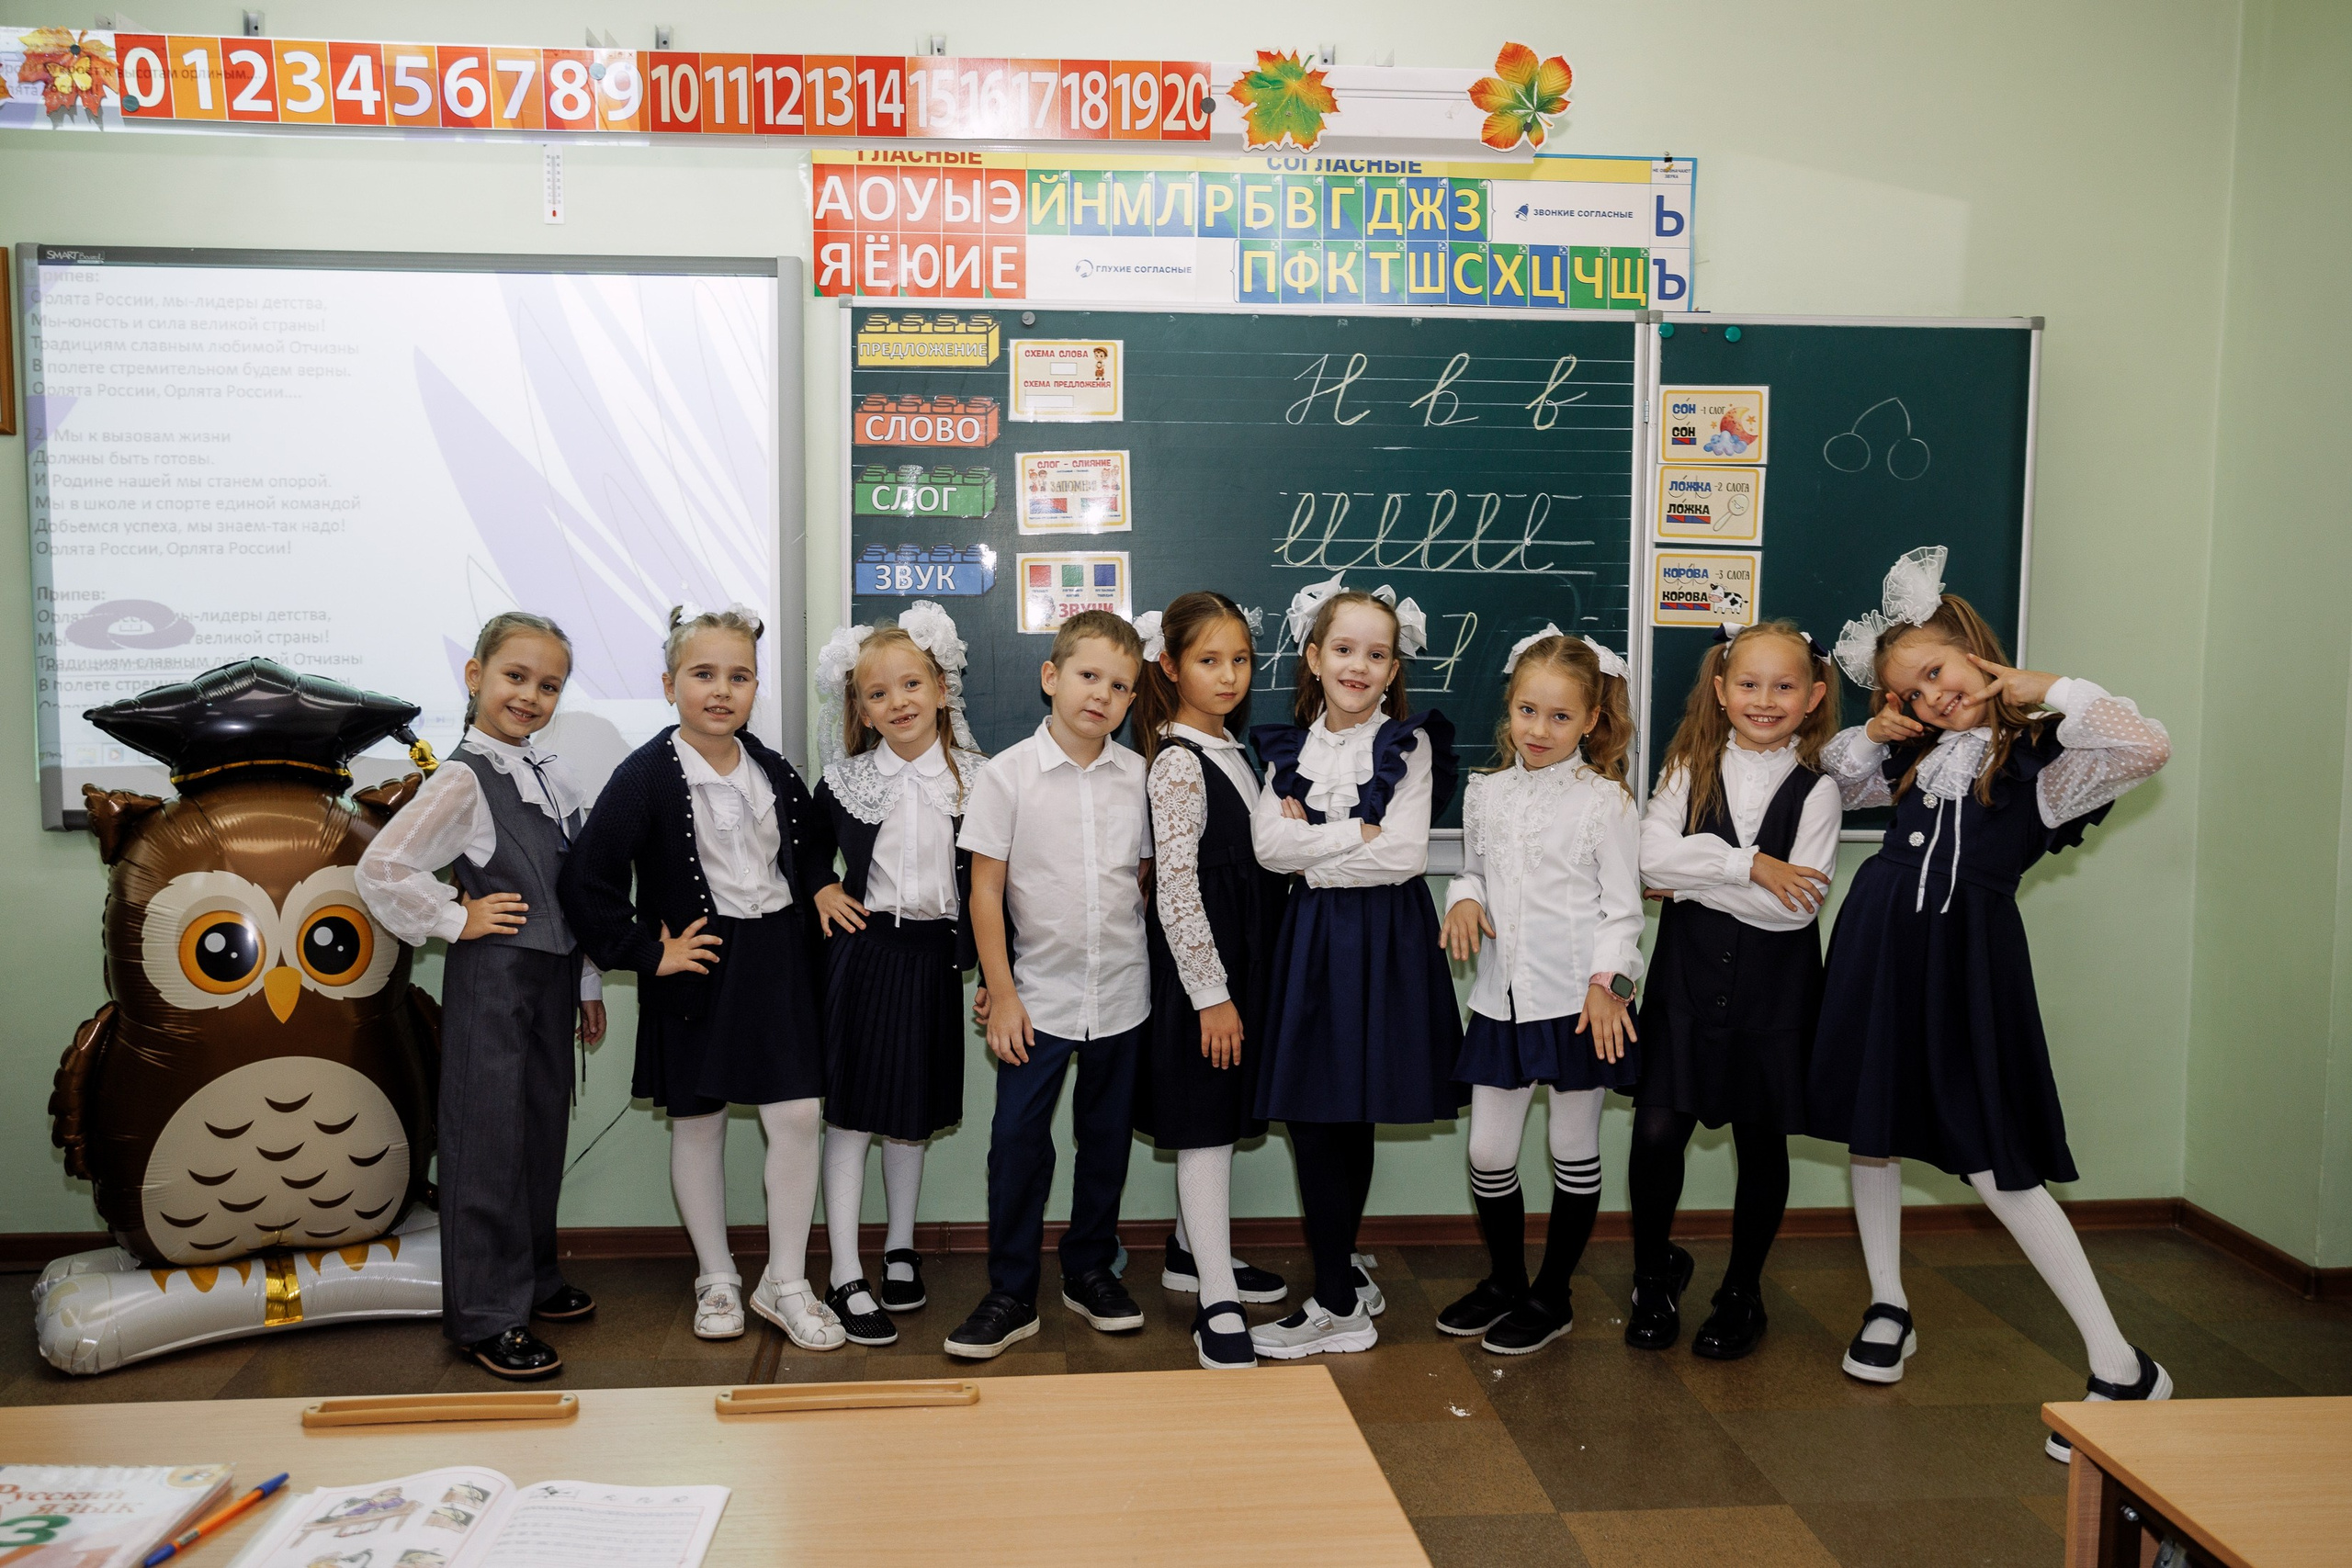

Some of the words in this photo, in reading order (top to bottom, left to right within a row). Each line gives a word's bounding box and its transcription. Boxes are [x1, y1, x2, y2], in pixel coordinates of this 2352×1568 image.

[123, 47, 165, 107] 0
[183, 49, 213, 109] 1
[230, 50, 273, 111] 2
[284, 51, 324, 113] 3
[335, 54, 380, 116] 4
[394, 56, 434, 117] 5
[444, 56, 487, 119] 6
[496, 60, 537, 119] 7
[549, 62, 592, 120] 8
[605, 62, 643, 121] 9
[650, 63, 699, 123] 10
[705, 65, 749, 125] 11
[755, 66, 804, 126] 12
[806, 66, 854, 127] 13
[857, 68, 904, 128] 14
[909, 69, 957, 129] 15
[960, 69, 1007, 130] 16
[1012, 71, 1057, 130] 17
[1061, 71, 1108, 130] 18
[1113, 72, 1159, 131] 19
[1162, 73, 1209, 131] 20
[1533, 209, 1575, 217] ЗВОНКИЕ
[1577, 209, 1634, 219] СОГЛАСНЫЕ
[47, 250, 78, 260] SMART
[1096, 265, 1132, 274] ГЛУХИЕ
[1134, 265, 1193, 274] СОГЛАСНЫЕ
[96, 291, 159, 309] России,
[163, 297, 258, 311] мы-лидеры
[262, 299, 327, 311] детства,
[31, 312, 128, 329] Мы-юность
[133, 319, 142, 329] и
[148, 319, 186, 330] сила
[191, 316, 258, 331] великой
[263, 318, 326, 333] страны!
[31, 335, 126, 354] Традициям
[130, 340, 204, 353] славным
[209, 339, 285, 354] любимой
[289, 341, 359, 355] Отчизны
[859, 342, 988, 359] ПРЕДЛОЖЕНИЕ
[1024, 349, 1055, 358] СХЕМА
[1058, 350, 1089, 358] СЛОВА
[32, 357, 42, 372] В
[48, 364, 105, 374] полете
[109, 363, 238, 377] стремительном
[243, 362, 292, 379] будем
[298, 366, 352, 379] верны.
[32, 381, 92, 398] Орлята
[97, 383, 161, 399] России,
[164, 384, 221, 400] Орлята
[1054, 380, 1112, 389] ПРЕДЛОЖЕНИЯ
[54, 428, 83, 442] Мы
[89, 432, 97, 442] к
[102, 432, 175, 443] вызовам
[178, 432, 232, 443] жизни
[865, 415, 980, 443] СЛОВО
[33, 450, 104, 467] Должны
[109, 452, 149, 465] быть
[154, 454, 215, 466] готовы.
[1037, 460, 1060, 469] СЛОГ
[1072, 459, 1112, 468] СЛИЯНИЕ
[35, 472, 46, 487] И
[52, 474, 113, 490] Родине
[119, 473, 171, 487] нашей
[176, 478, 202, 488] мы
[208, 478, 264, 488] станем
[268, 472, 332, 491] опорой.
[35, 496, 64, 510] Мы
[70, 500, 79, 510] в
[85, 500, 136, 510] школе
[141, 500, 152, 510] и
[156, 500, 211, 513] спорте
[216, 495, 276, 513] единой
[281, 493, 360, 513] командой
[871, 485, 957, 512] СЛОГ
[34, 518, 119, 536] Добьемся
[124, 521, 182, 536] успеха,
[187, 522, 212, 533] мы
[301, 518, 345, 536] надо!
[36, 541, 96, 558] Орлята
[100, 542, 164, 557] России,
[166, 542, 224, 558] Орлята
[229, 540, 291, 555] России!
[875, 565, 956, 591] ЗВУК
[37, 587, 106, 604] Припев:
[266, 610, 332, 624] детства,
[196, 630, 263, 645] великой
[267, 629, 329, 646] страны!
[294, 653, 363, 666] Отчизны
[0, 1514, 73, 1548] 3
